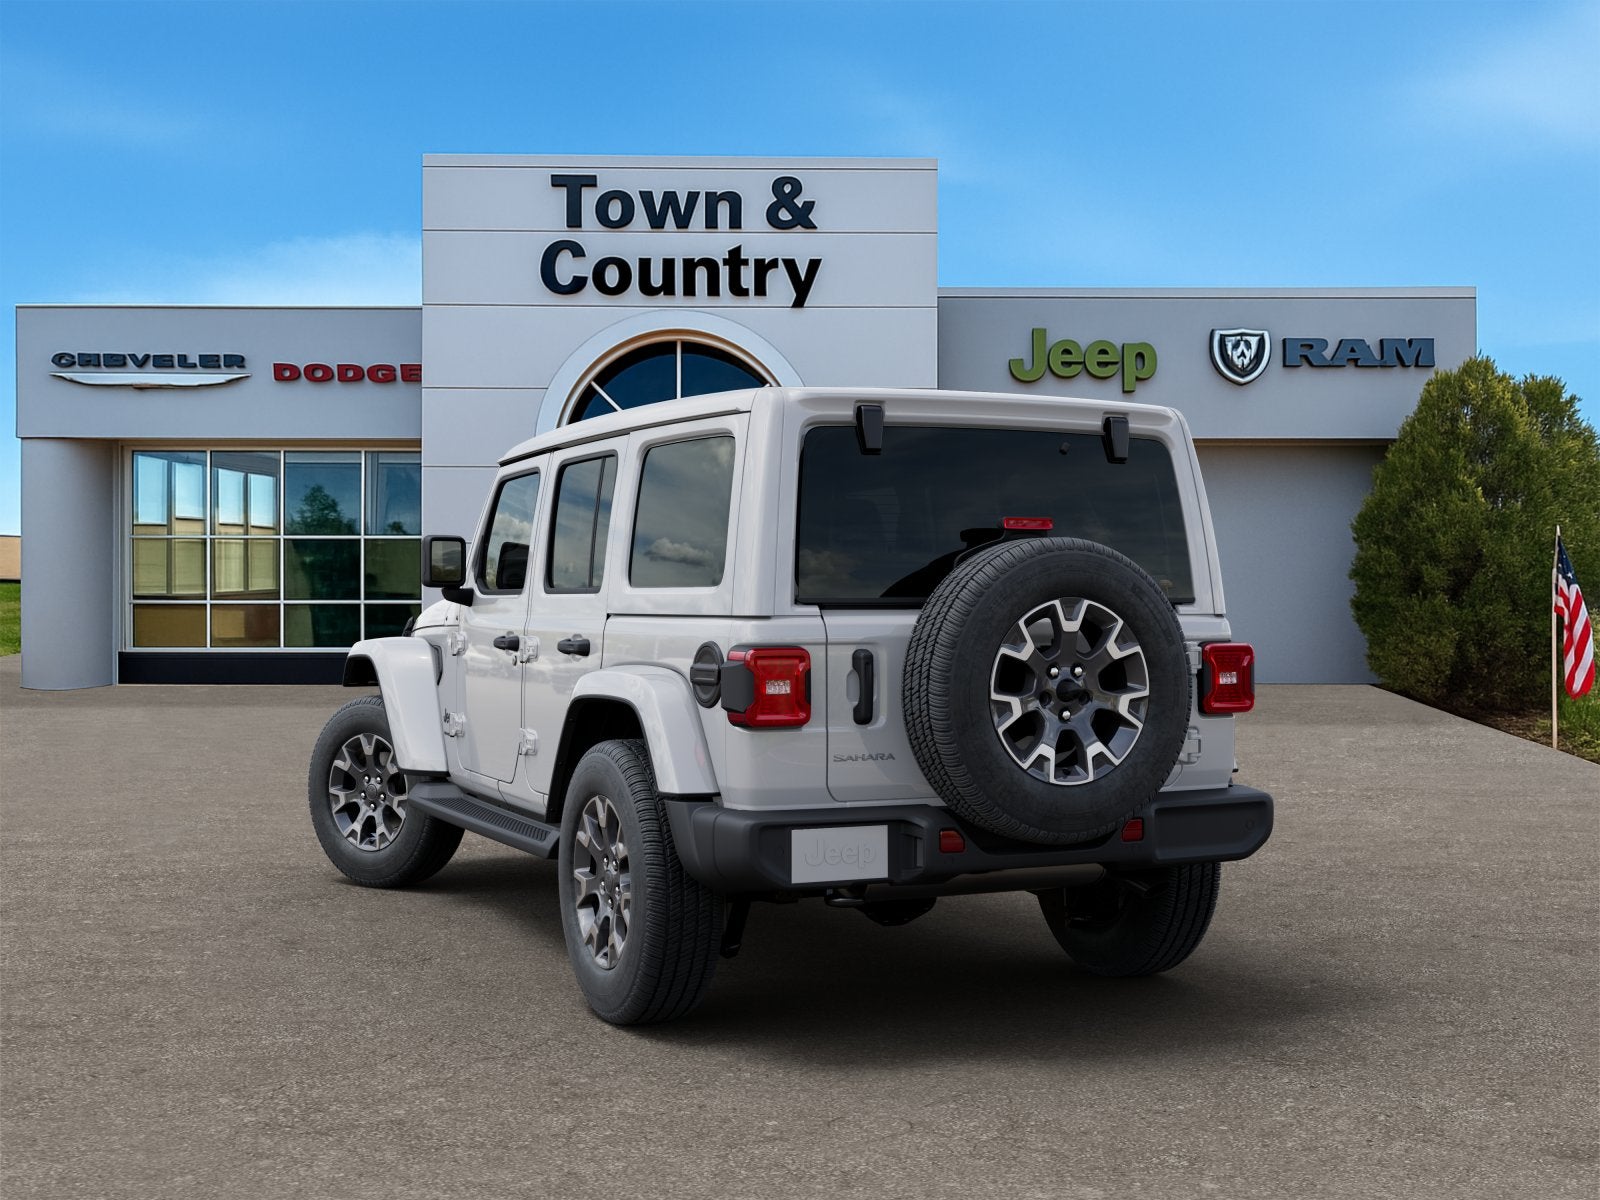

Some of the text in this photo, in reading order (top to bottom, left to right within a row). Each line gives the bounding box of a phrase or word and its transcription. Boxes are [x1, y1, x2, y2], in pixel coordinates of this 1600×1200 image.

[550, 174, 818, 230] Town &
[540, 239, 822, 308] Country
[1008, 327, 1158, 393] Jeep
[1282, 337, 1435, 368] RAM
[273, 362, 422, 383] DODGE
[832, 752, 896, 763] SAHARA
[804, 838, 876, 870] Jeep
